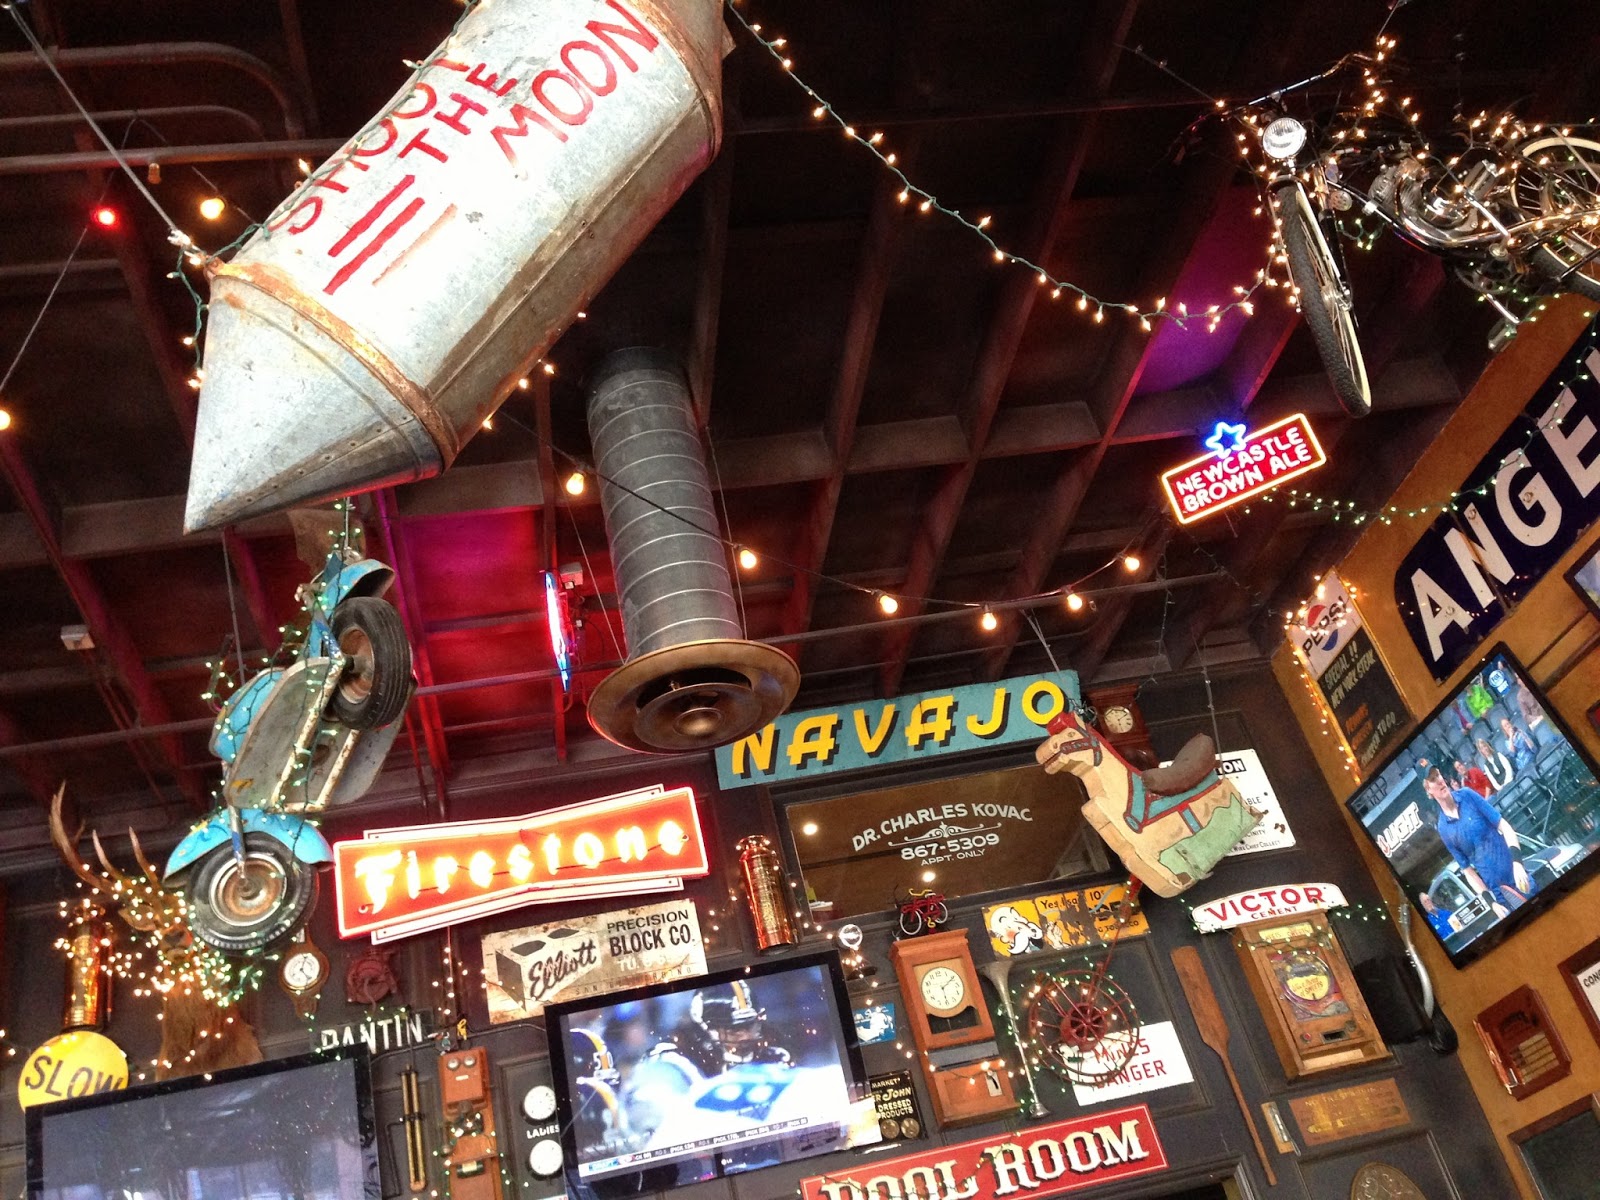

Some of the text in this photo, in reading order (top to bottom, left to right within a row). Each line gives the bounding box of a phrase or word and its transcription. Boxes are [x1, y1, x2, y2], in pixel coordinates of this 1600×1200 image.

[490, 0, 659, 180] MOON
[398, 62, 518, 164] THE
[1175, 426, 1304, 496] NEWCASTLE
[1183, 443, 1312, 513] BROWN ALE
[1410, 347, 1600, 662] ANGE
[731, 680, 1068, 777] NAVAJO
[851, 803, 1033, 851] DR. CHARLES KOVAC
[900, 833, 1000, 860] 867-5309
[354, 820, 687, 915] Firestone
[920, 848, 986, 866] APPT. ONLY
[607, 909, 689, 933] PRECISION
[1205, 886, 1326, 922] VICTOR
[1251, 905, 1298, 920] CEMENT
[609, 922, 696, 957] BLOCK CO.
[528, 940, 598, 1001] Elliott
[24, 1055, 124, 1100] SLOW
[881, 1086, 912, 1102] JOHN
[1094, 1059, 1168, 1090] DANGER
[876, 1105, 914, 1120] PRODUCTS
[877, 1098, 912, 1113] DRESSED
[525, 1124, 561, 1140] LADIES
[983, 1118, 1150, 1195] ROOM
